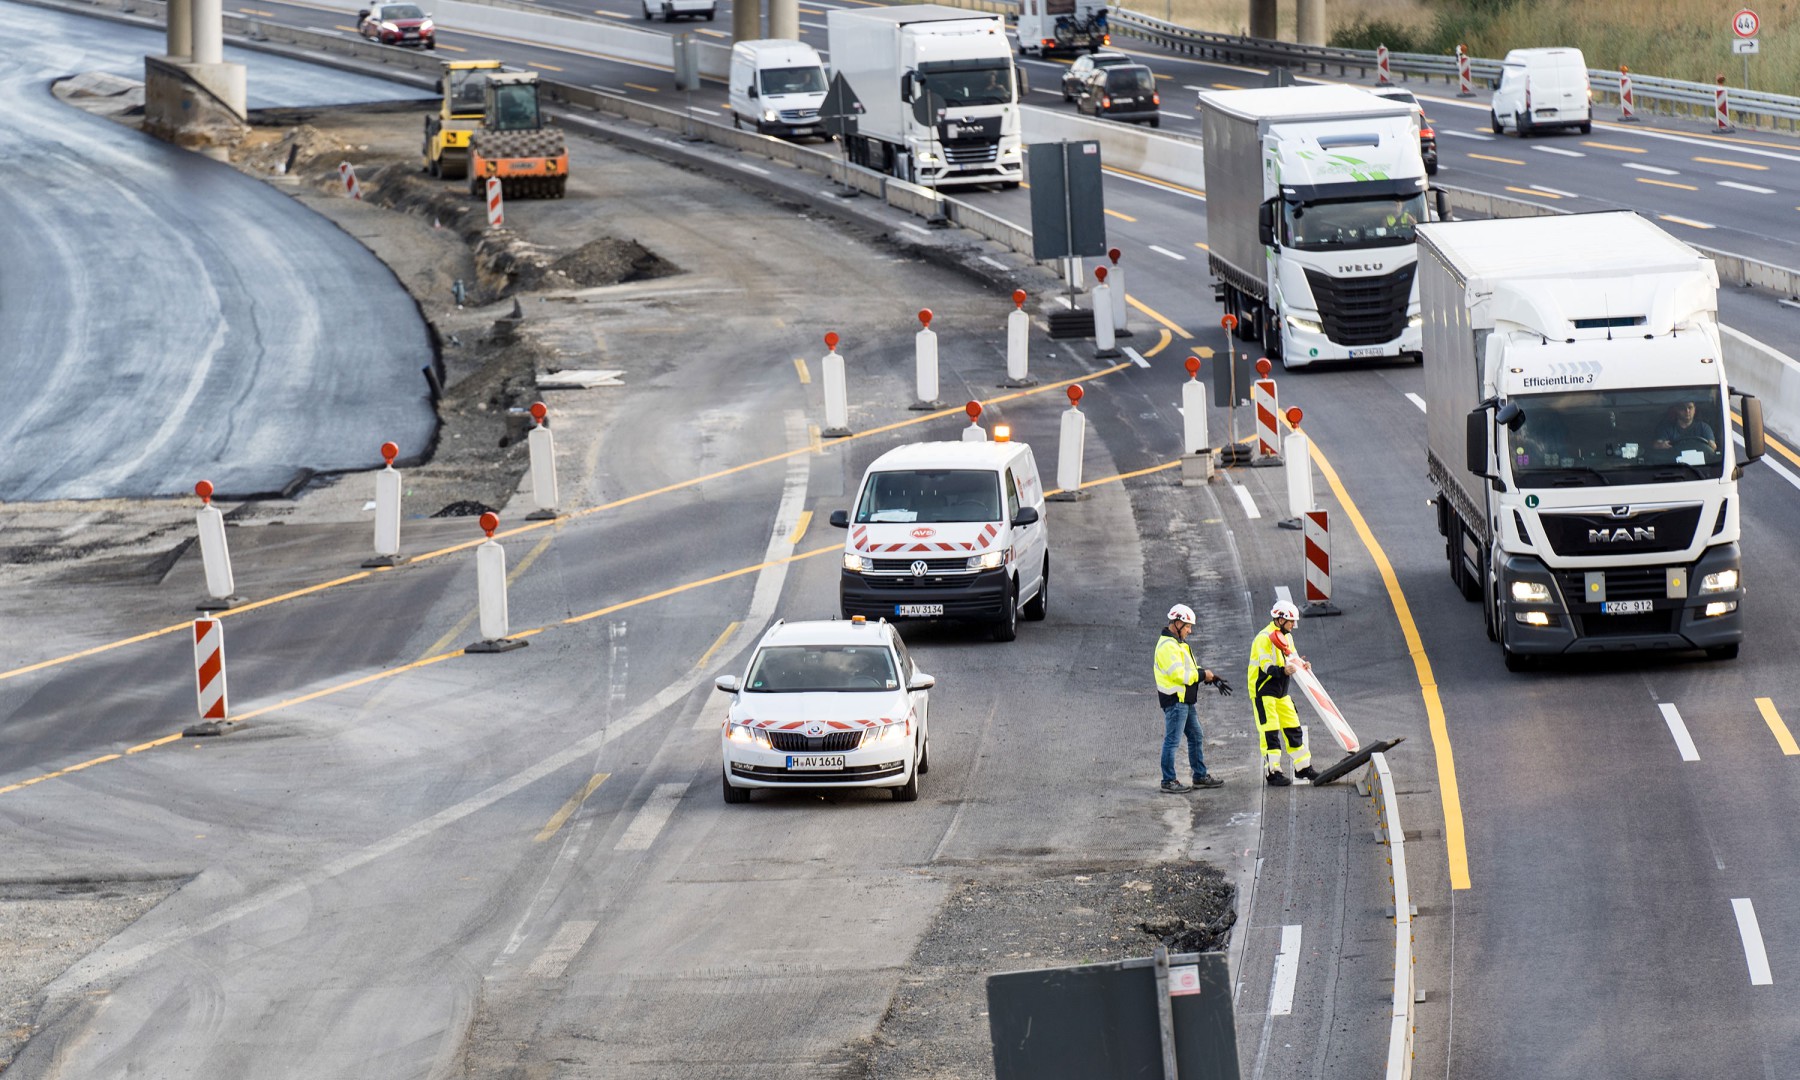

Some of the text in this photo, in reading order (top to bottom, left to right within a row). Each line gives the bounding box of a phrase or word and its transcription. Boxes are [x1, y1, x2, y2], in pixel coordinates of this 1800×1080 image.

[1338, 263, 1383, 273] IVECO
[1523, 373, 1594, 387] EfficientLine 3
[1588, 526, 1655, 543] MAN
[922, 605, 942, 613] 3134
[1607, 601, 1652, 611] KZG 912
[805, 757, 817, 766] AV
[819, 757, 843, 766] 1616
